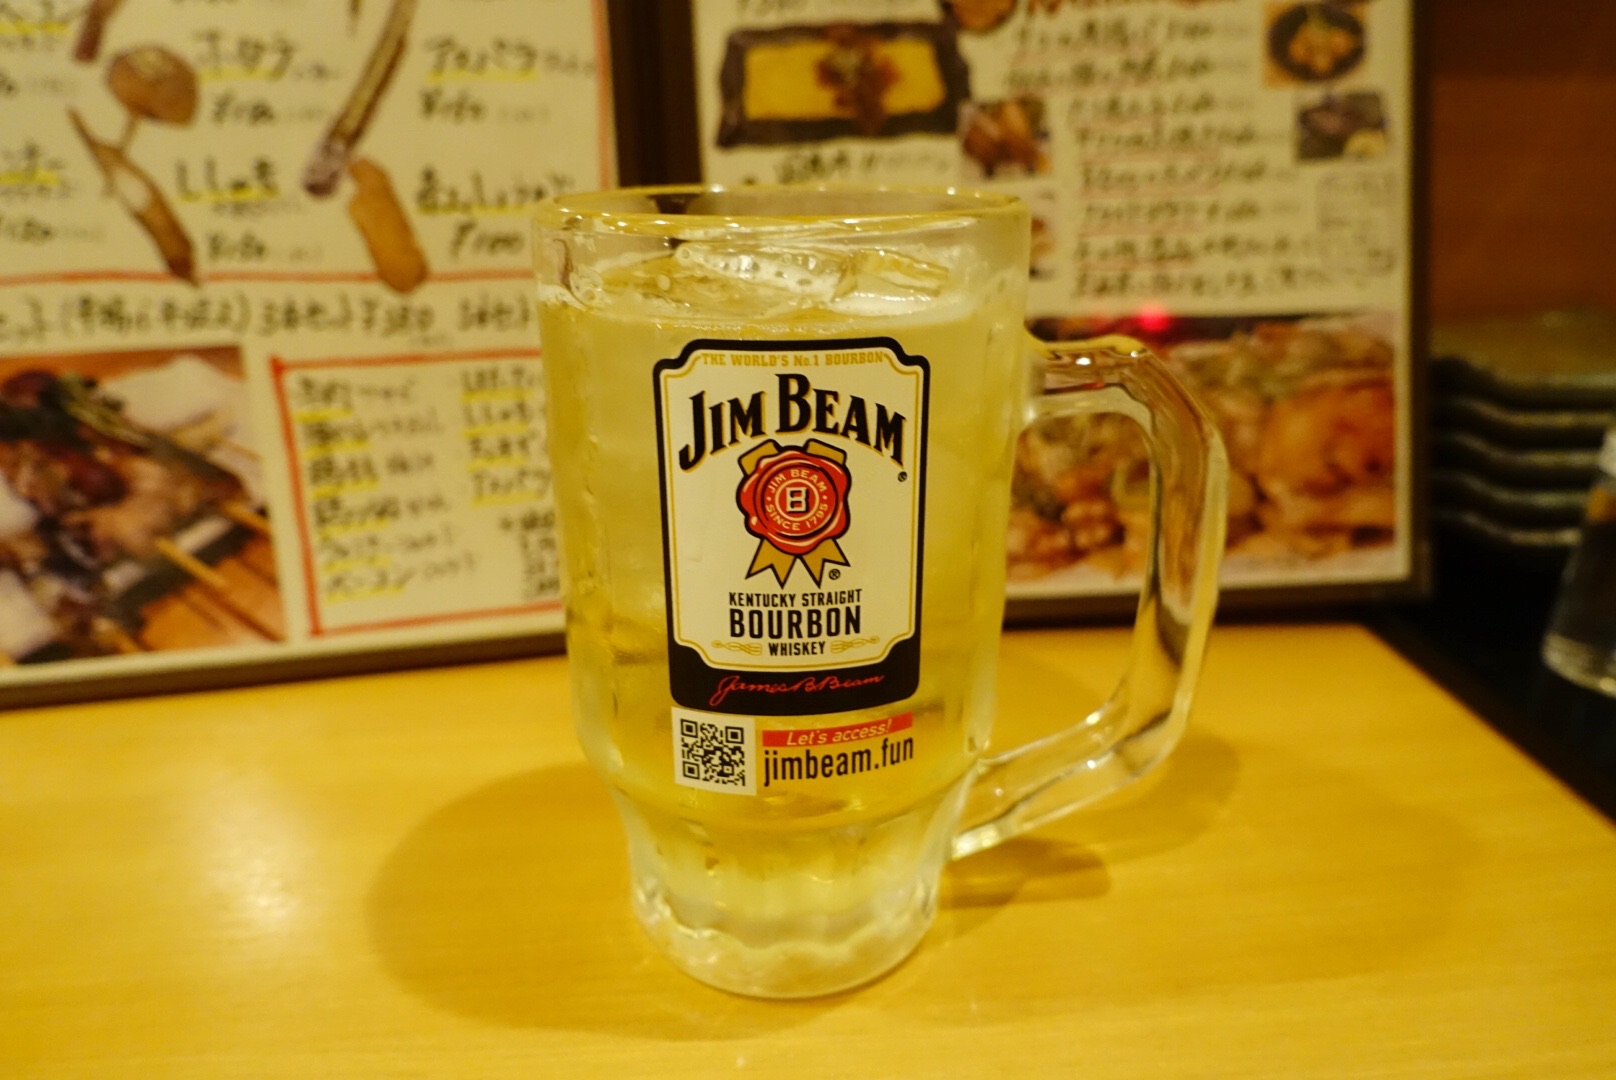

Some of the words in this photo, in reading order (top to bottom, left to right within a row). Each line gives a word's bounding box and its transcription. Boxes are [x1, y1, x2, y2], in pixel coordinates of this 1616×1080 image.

[702, 352, 726, 366] THE
[731, 354, 789, 367] WORLD'S
[825, 351, 884, 365] BOURBON
[679, 390, 768, 472] JIM
[774, 373, 908, 470] BEAM
[768, 473, 786, 493] JIM
[790, 468, 828, 492] BEAM
[765, 503, 800, 531] SINCE
[805, 503, 829, 528] 1795
[729, 592, 796, 608] KENTUCKY
[801, 588, 862, 607] STRAIGHT
[729, 605, 861, 639] BOURBON
[768, 641, 826, 656] WHISKEY
[786, 729, 827, 746] Let's
[832, 718, 892, 742] access!
[764, 737, 913, 788] jimbeam.fun
